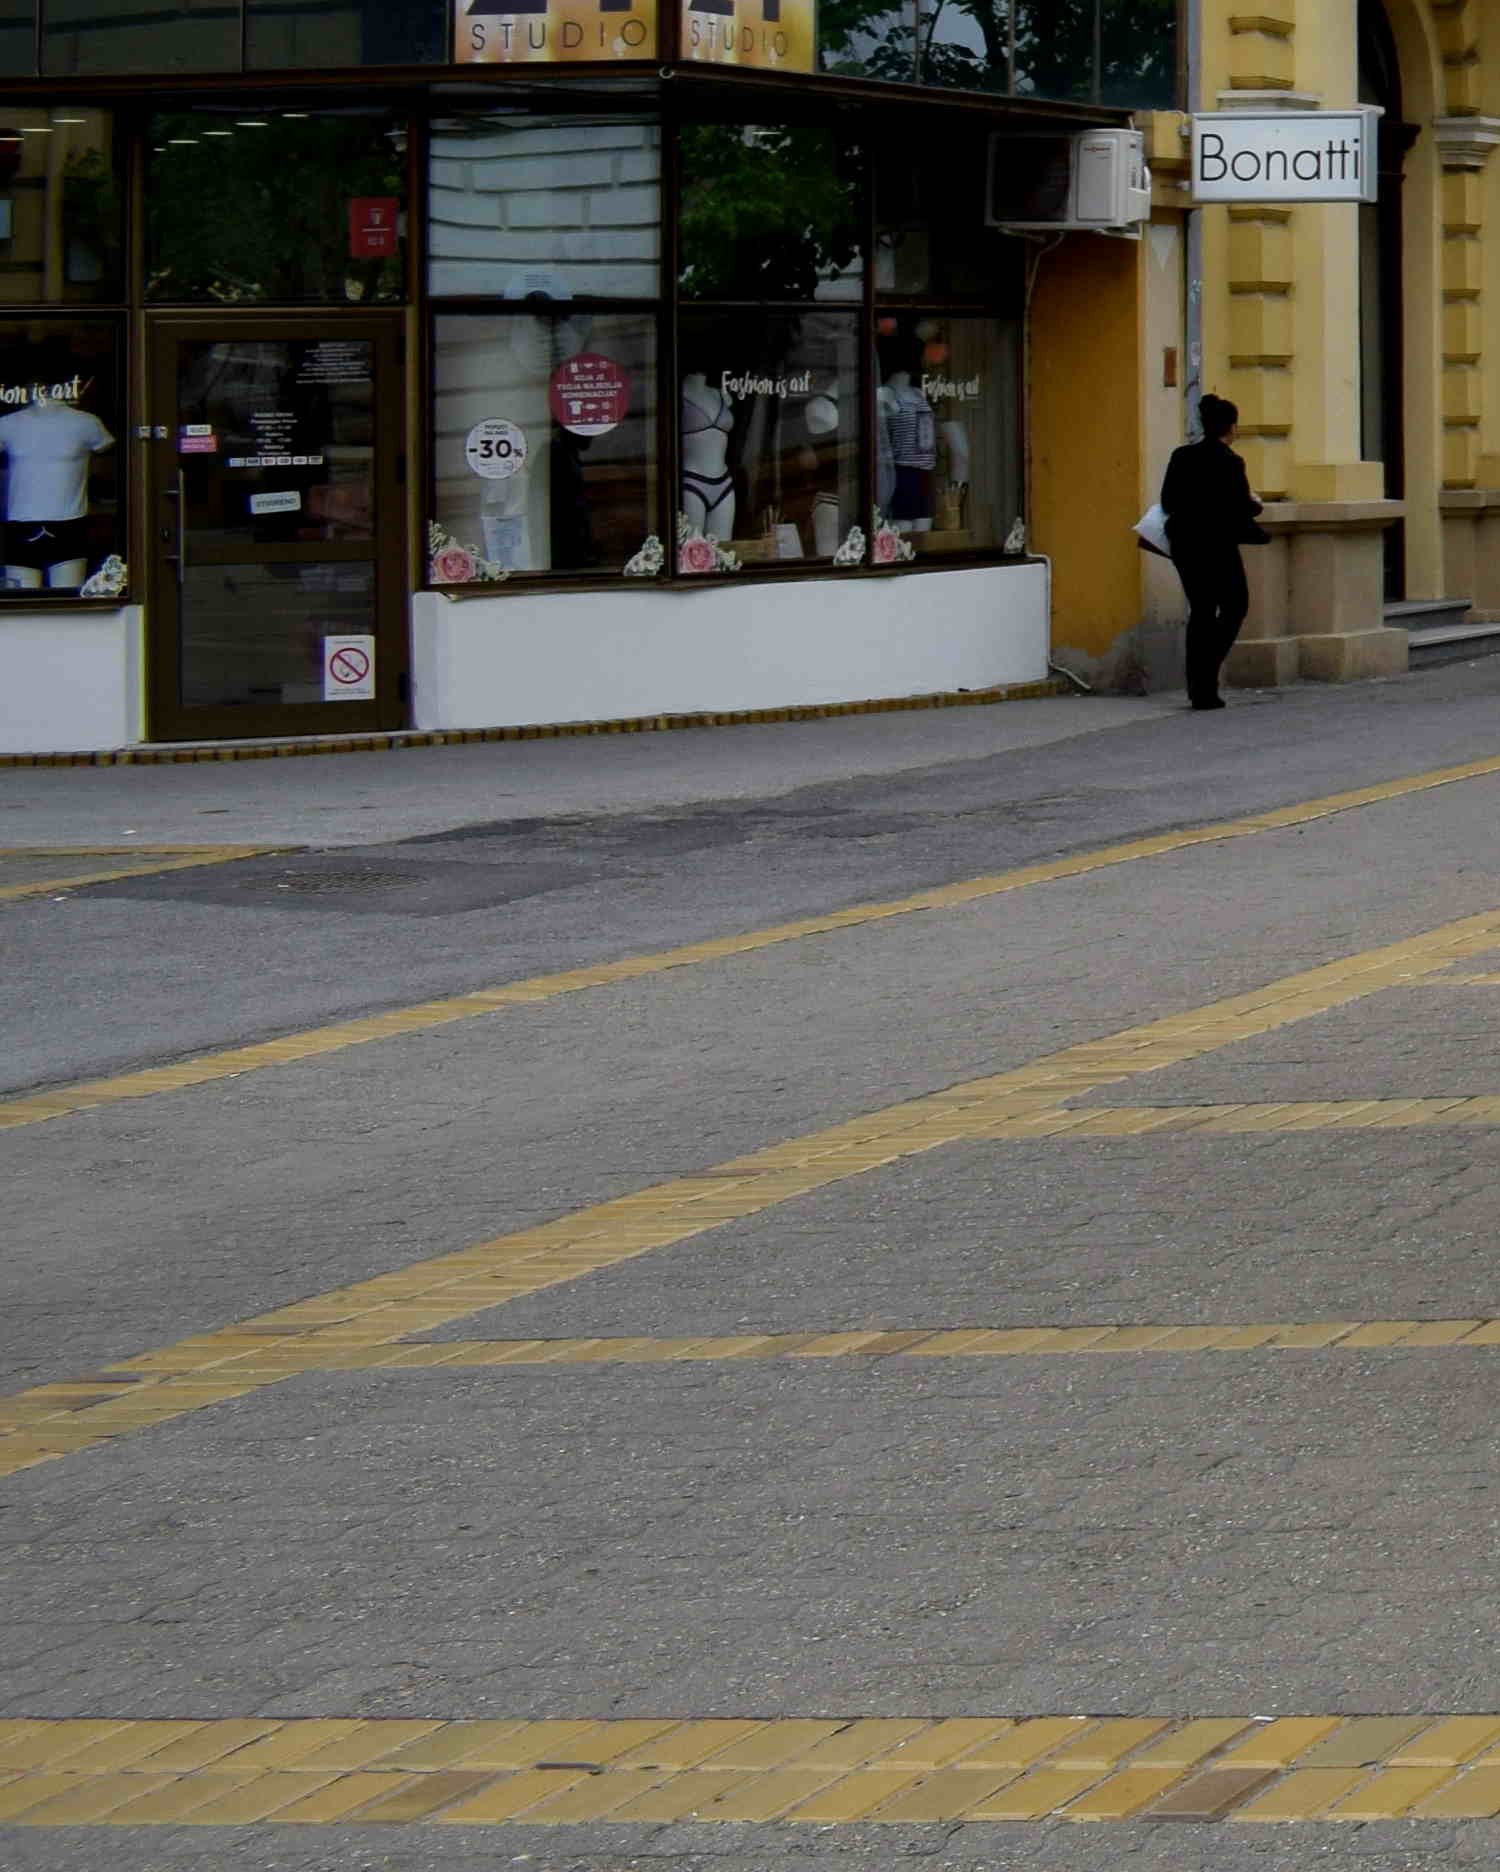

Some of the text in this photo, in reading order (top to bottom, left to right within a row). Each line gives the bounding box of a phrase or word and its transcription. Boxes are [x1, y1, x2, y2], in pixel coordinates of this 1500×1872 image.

[471, 19, 647, 51] STUDIO
[691, 19, 788, 57] STUDIO
[1200, 134, 1360, 181] Bonatti
[52, 374, 80, 400] art
[721, 370, 811, 400] Fashion is art
[921, 374, 955, 403] Fashion
